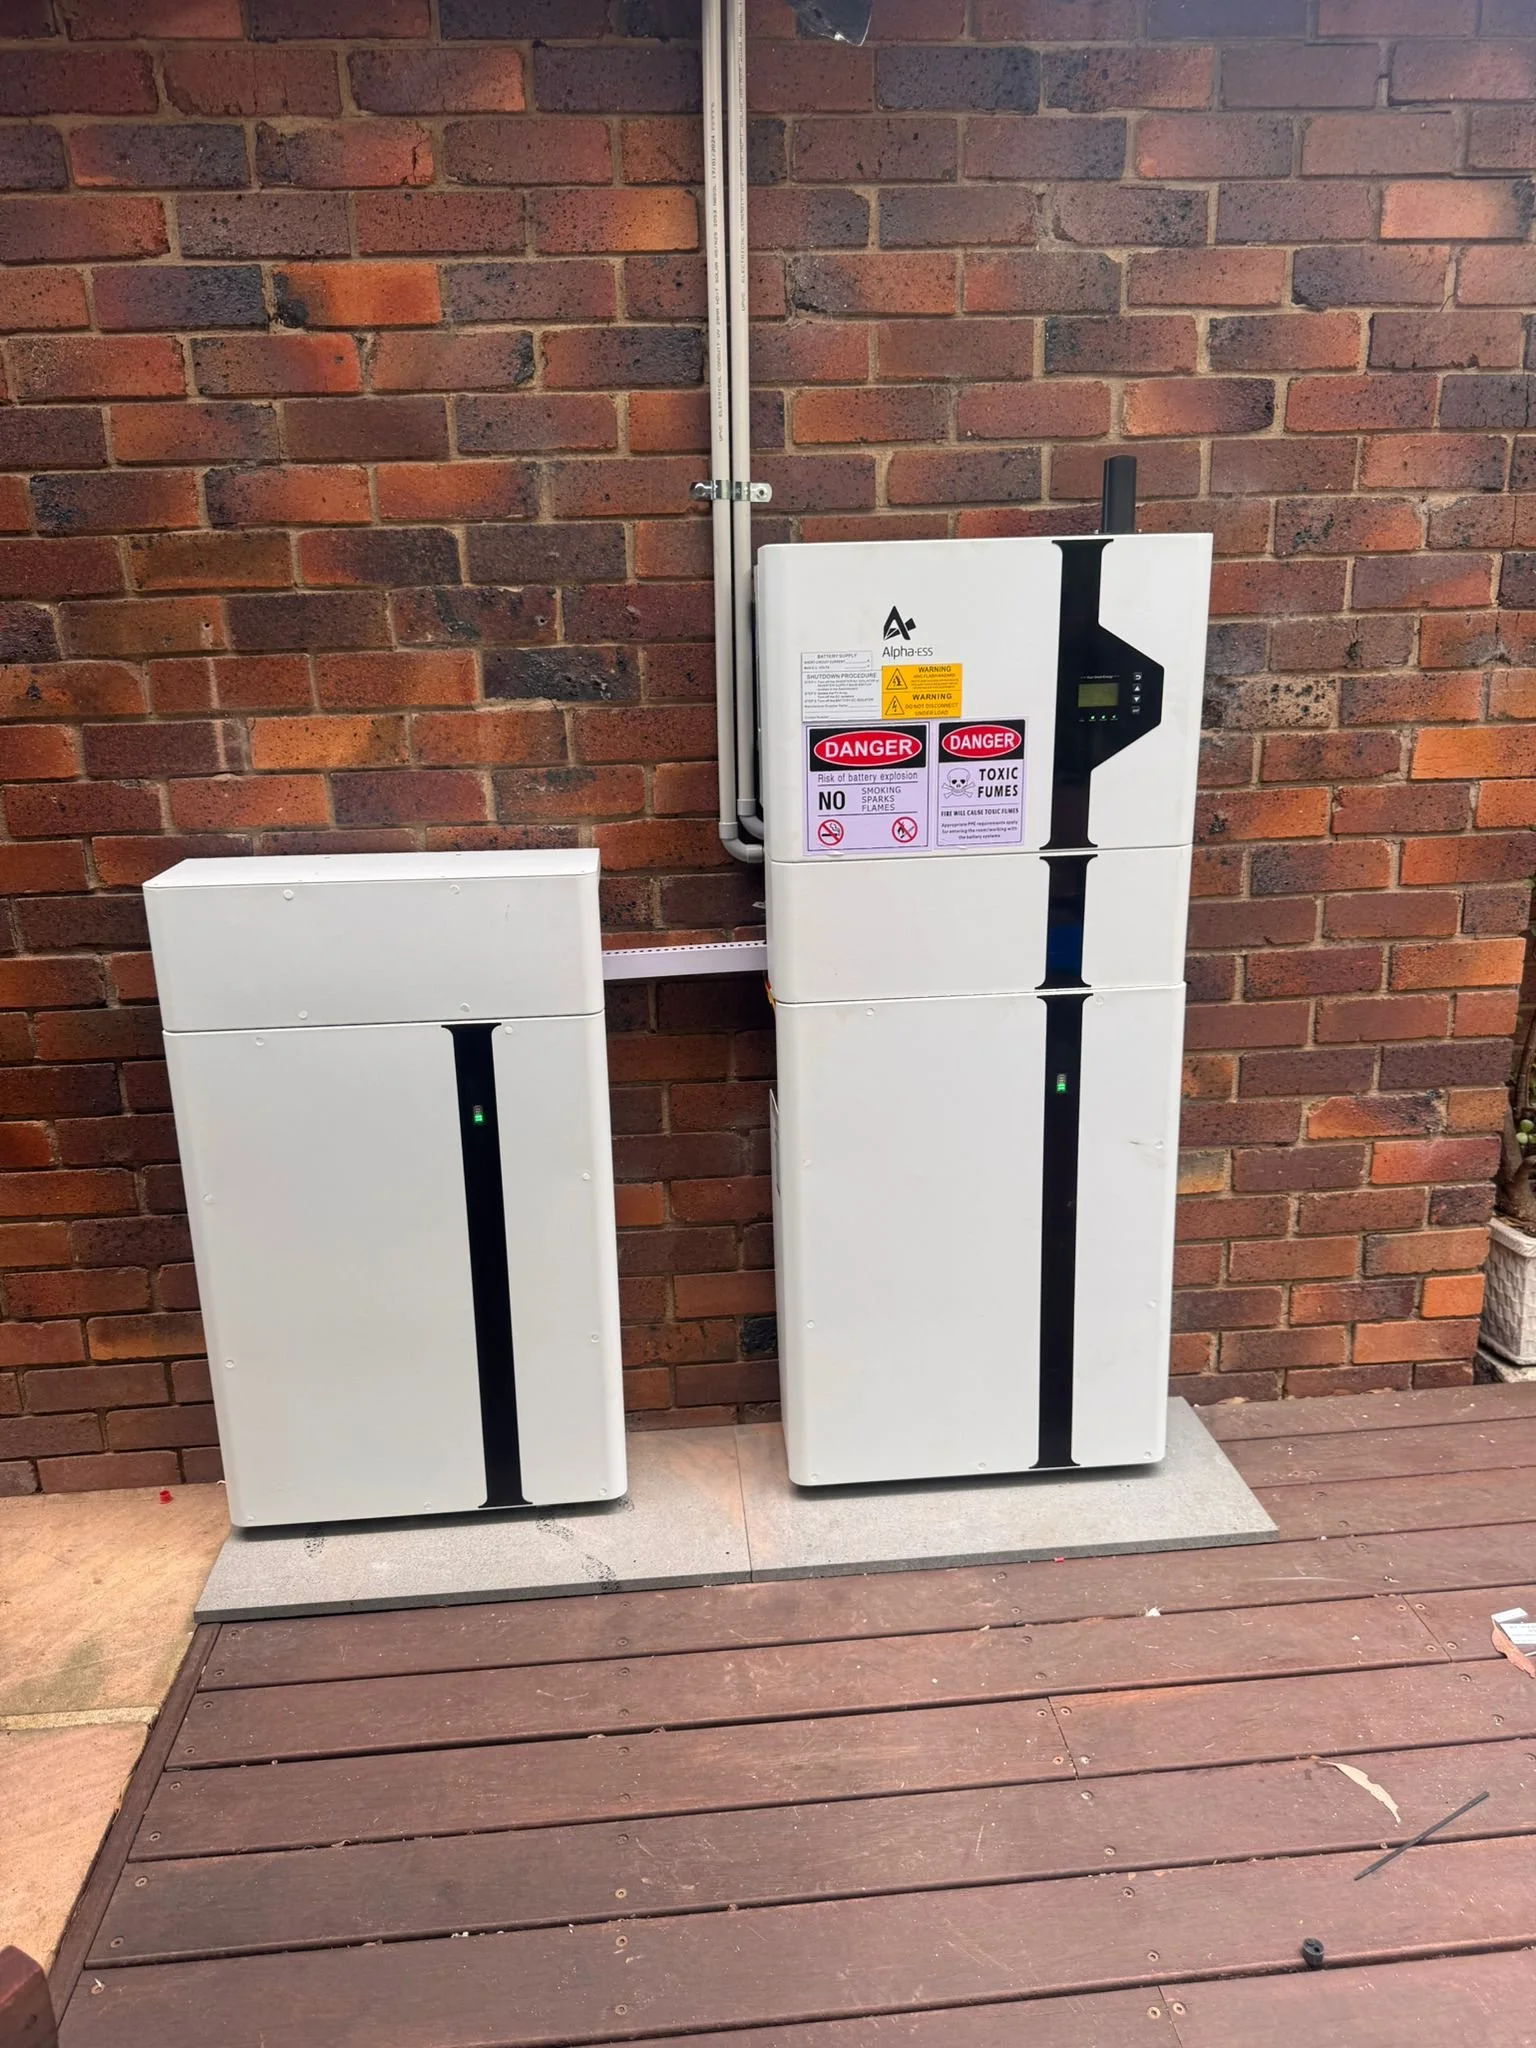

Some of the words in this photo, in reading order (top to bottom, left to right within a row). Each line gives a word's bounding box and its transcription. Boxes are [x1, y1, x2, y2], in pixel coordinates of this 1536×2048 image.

[912, 693, 952, 701] WARNING
[950, 732, 1015, 750] DANGER
[825, 739, 913, 758] DANGER
[818, 773, 835, 783] Risk
[837, 773, 845, 782] of
[848, 772, 877, 784] battery
[880, 771, 918, 783] explosion
[979, 767, 1018, 781] TOXIC
[862, 786, 901, 795] SMOKING
[978, 784, 1018, 798] FUMES
[819, 791, 846, 810] NO
[862, 795, 895, 803] SPARKS
[862, 803, 895, 812] FLAMES
